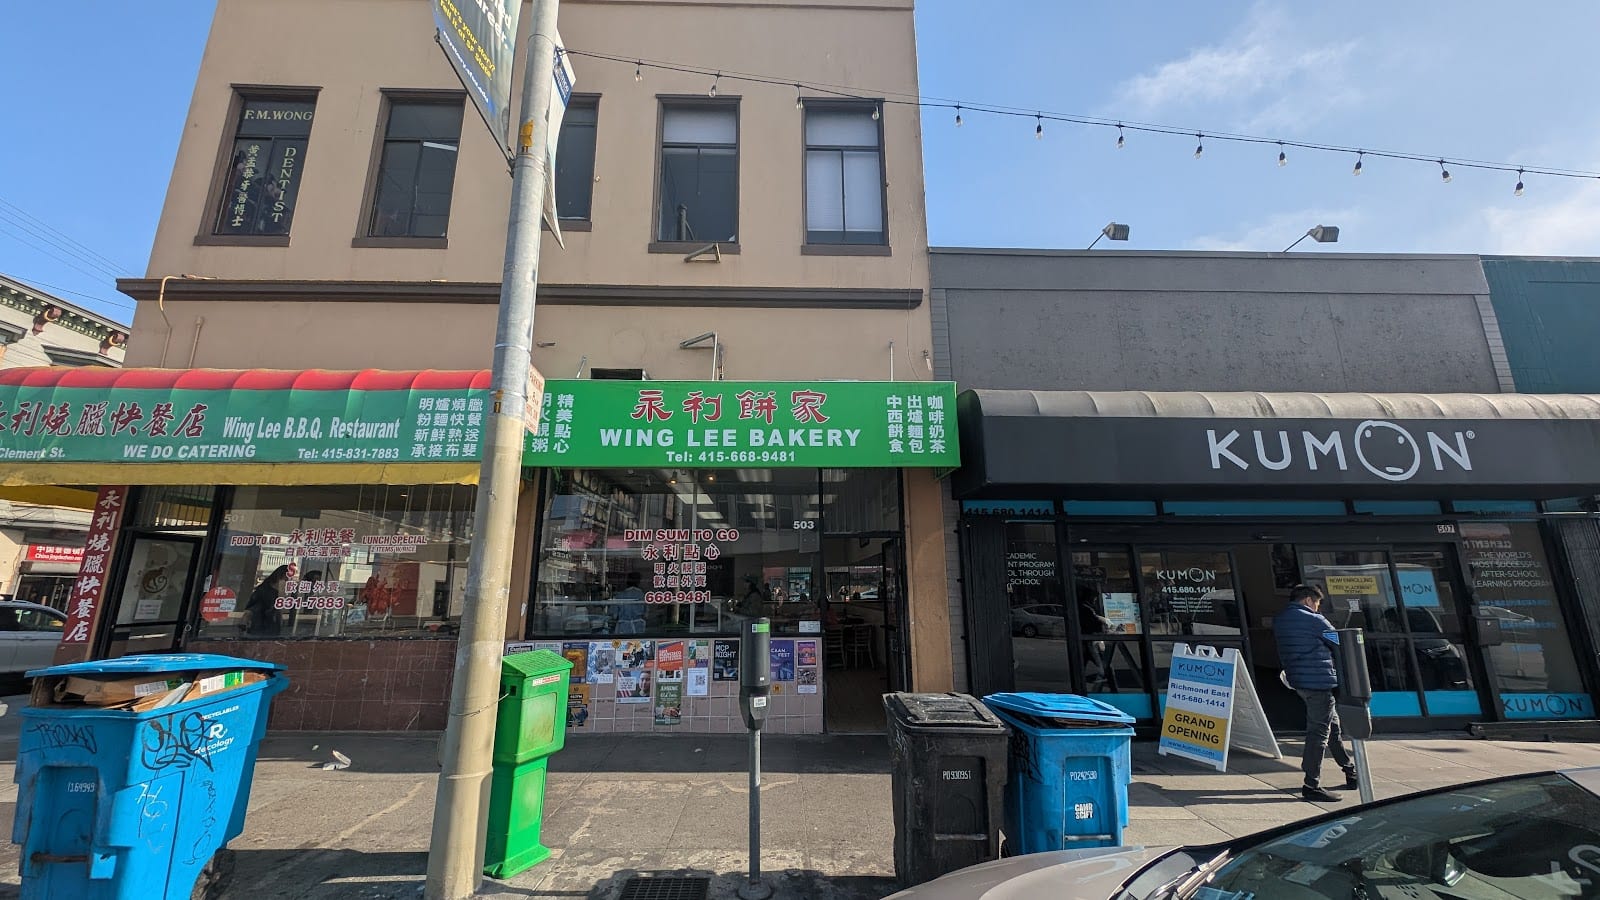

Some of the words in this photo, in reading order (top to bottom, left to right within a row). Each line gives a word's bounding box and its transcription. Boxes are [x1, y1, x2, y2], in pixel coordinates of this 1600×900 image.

[271, 147, 297, 223] DENTIST
[630, 389, 831, 424] 永利餅家
[223, 417, 254, 442] Wing
[257, 417, 280, 439] Lee
[283, 417, 323, 439] B.B.Q.
[329, 417, 400, 439] Restaurant
[553, 394, 574, 454] 精美點心
[886, 394, 904, 453] 中西餅食
[907, 394, 925, 454] 出爐麵包
[927, 395, 946, 454] 咖啡奶茶
[413, 428, 480, 442] 新鮮熟送
[600, 428, 674, 447] WING
[687, 428, 737, 447] LEE
[749, 428, 861, 447] BAKERY
[49, 447, 66, 459] St.
[123, 445, 149, 458] WE
[150, 445, 174, 458] DO
[177, 445, 256, 458] CATERING
[298, 448, 319, 459] Tel:
[321, 448, 399, 459] 415-831-7883
[666, 451, 693, 462] Tel:
[698, 450, 796, 463] 415-668-9481
[1206, 420, 1473, 481] KUMON
[793, 521, 815, 529] 503
[231, 536, 254, 546] FOOD
[255, 536, 267, 545] TO
[268, 536, 281, 546] GO
[288, 528, 355, 545] 永利快餐
[362, 536, 390, 545] LUNCH
[391, 534, 427, 545] SPECIAL
[624, 529, 652, 541] DIM
[655, 529, 689, 541] SUM
[693, 529, 713, 541] TO
[716, 529, 739, 541] GO
[643, 543, 720, 560] 永利點心
[1156, 567, 1217, 582] KUMON
[274, 597, 345, 609] 831-7883
[645, 590, 711, 603] 668-9481
[1178, 663, 1225, 677] KUMON
[1170, 683, 1209, 695] Richmond
[1211, 689, 1230, 698] East
[1171, 693, 1225, 708] 415-680-1414
[1503, 694, 1583, 715] KUMON
[1174, 713, 1215, 730] GRAND
[1168, 724, 1219, 745] OPENING
